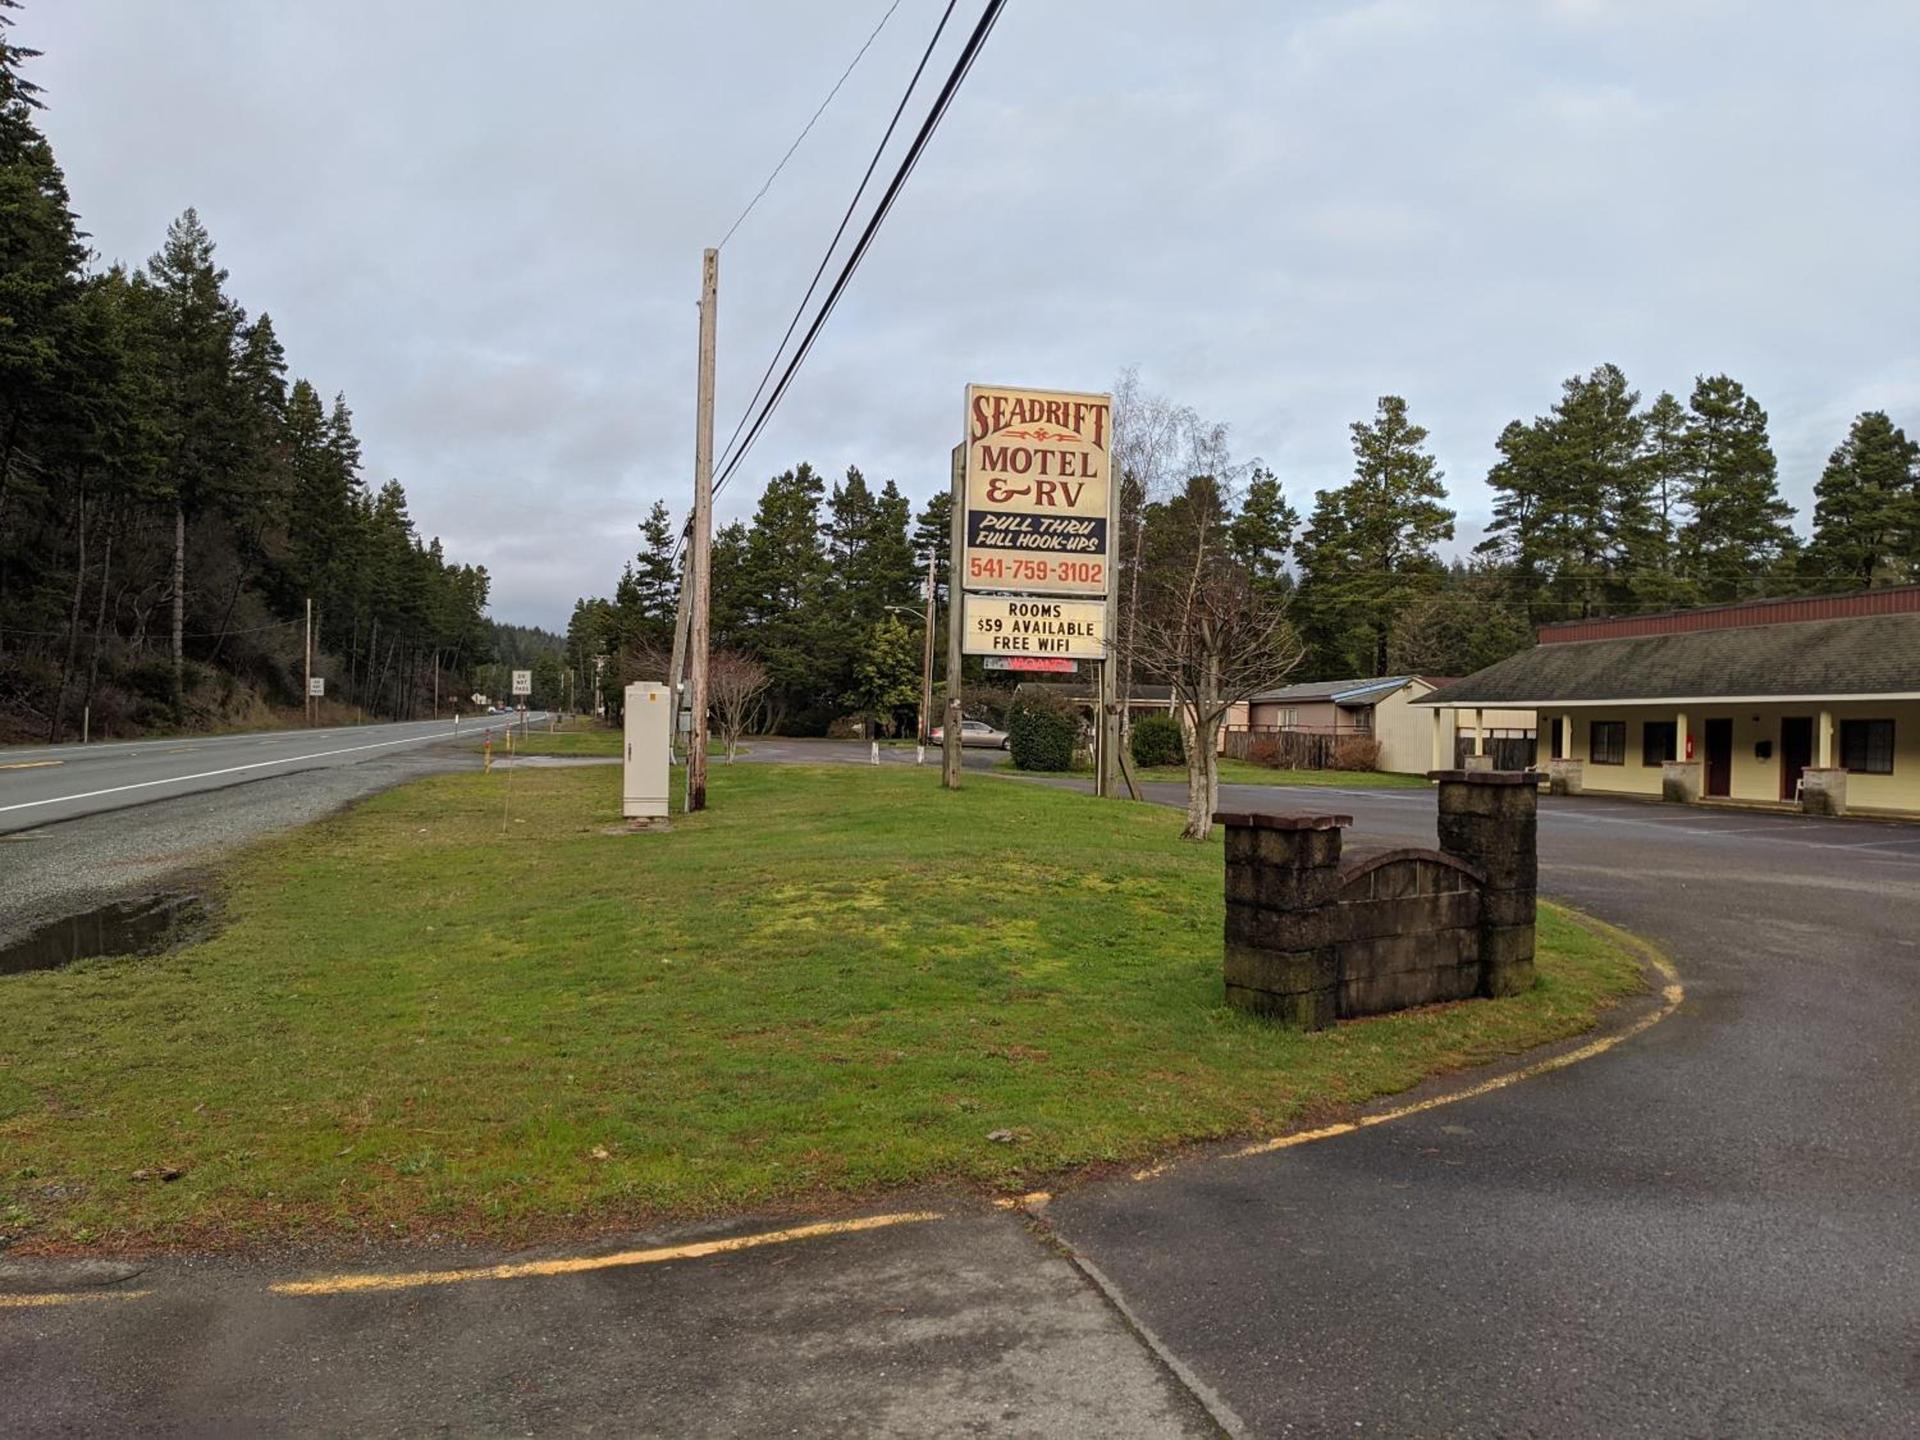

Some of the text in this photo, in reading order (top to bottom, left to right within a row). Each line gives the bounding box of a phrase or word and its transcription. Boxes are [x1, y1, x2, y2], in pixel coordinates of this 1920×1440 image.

[971, 394, 1109, 450] SEADRIFT
[980, 445, 1098, 478] MOTEL
[986, 478, 1085, 508] & RV
[979, 514, 1095, 535] PULL THRU
[975, 531, 1099, 552] FULL HOOK-UPS
[970, 557, 1102, 584] 541-759-3102
[1009, 602, 1061, 618] ROOMS
[977, 617, 1094, 636] $59 AVAILABLE
[993, 635, 1070, 652] FREE WIFI
